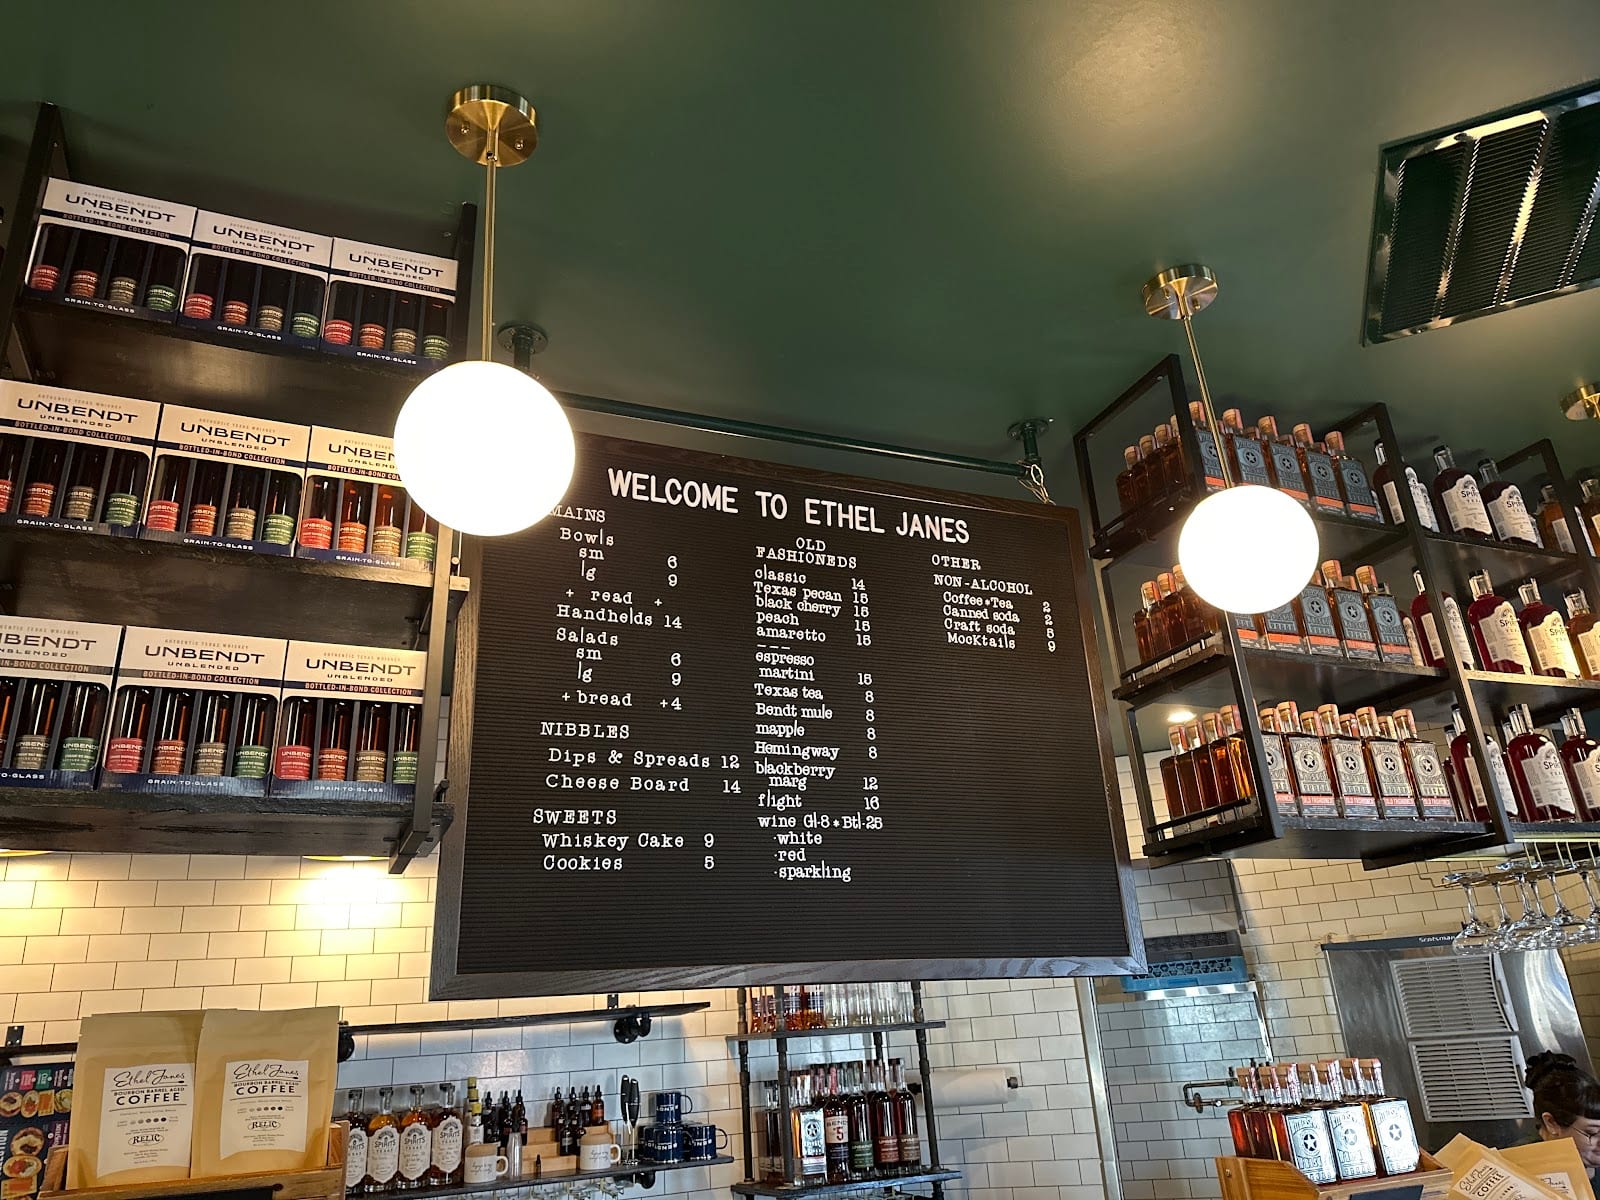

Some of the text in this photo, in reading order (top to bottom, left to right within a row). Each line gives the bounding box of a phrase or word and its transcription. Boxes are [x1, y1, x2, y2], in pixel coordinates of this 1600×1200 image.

[66, 194, 176, 223] UNBENDT
[86, 209, 152, 225] UNBLENDED
[128, 225, 170, 239] COLLECTION
[214, 226, 315, 252] UNBENDT
[232, 240, 294, 255] UNBLENDED
[272, 256, 310, 268] COLLECTION
[350, 254, 444, 278] UNBENDT
[368, 267, 424, 280] UNBLENDED
[404, 282, 440, 293] COLLECTION
[18, 398, 138, 424] UNBENDT
[40, 414, 112, 428] UNBLENDED
[86, 431, 132, 442] COLLECTION
[181, 422, 291, 447] UNBENDT
[202, 438, 268, 452] UNBLENDED
[244, 453, 286, 465] COLLECTION
[608, 468, 970, 544] WELCOME TO ETHEL JANES
[560, 527, 614, 546] Bowls
[796, 537, 826, 551] OLD
[579, 548, 678, 569] sm 6
[756, 546, 857, 569] FASHIONEDS
[932, 554, 981, 570] OTHER
[582, 560, 678, 587] lg 9
[755, 564, 866, 591] classic 14
[754, 582, 797, 597] Texas
[802, 588, 842, 602] pecan
[933, 574, 1033, 595] NON-ALCOHOL
[591, 590, 633, 605] read
[755, 592, 792, 610] black
[797, 600, 841, 618] cherry
[943, 605, 1053, 626] Canned soda 2
[1043, 602, 1051, 613] 2
[557, 604, 683, 629] Handhelds 14
[756, 612, 799, 626] peach
[756, 626, 826, 642] amaretto
[944, 618, 980, 632] Craft
[986, 624, 1016, 635] soda
[0, 633, 97, 651] BENDT
[556, 627, 619, 646] Salads
[145, 645, 265, 665] UNBENDT
[1048, 641, 1056, 652] 9
[576, 648, 681, 667] sm 6
[756, 652, 815, 666] espresso
[40, 662, 89, 673] COLLECTION
[168, 662, 239, 671] UNBLENDED
[306, 659, 417, 676] UNBENDT
[578, 661, 682, 686] lg 9
[759, 667, 815, 681] martini
[214, 675, 260, 685] COLLECTION
[328, 674, 393, 683] UNBLENDED
[371, 687, 412, 696] COLLECTION
[577, 690, 633, 707] bread
[754, 683, 874, 703] Texas tea 8
[755, 703, 875, 722] Bendt mule 8
[540, 722, 630, 739] NIBBLES
[756, 720, 876, 740] mapple 8
[548, 748, 740, 769] Dips & Spreads 12
[754, 741, 878, 760] Hemingway 8
[754, 757, 836, 780] blackberry
[546, 774, 742, 794] Cheese Board 14
[769, 776, 879, 791] marg 12
[758, 789, 879, 811] flight 16
[533, 808, 617, 825] SWEETS
[758, 815, 796, 828] wine
[542, 833, 715, 852] Whiskey Cake 9
[543, 855, 715, 871] Cookies 5
[236, 1085, 295, 1095] COFFEE
[117, 1093, 180, 1106] COFFEE
[252, 1121, 277, 1129] RELIC
[133, 1134, 160, 1144] RELIC
[1477, 1174, 1504, 1197] COFFEE
